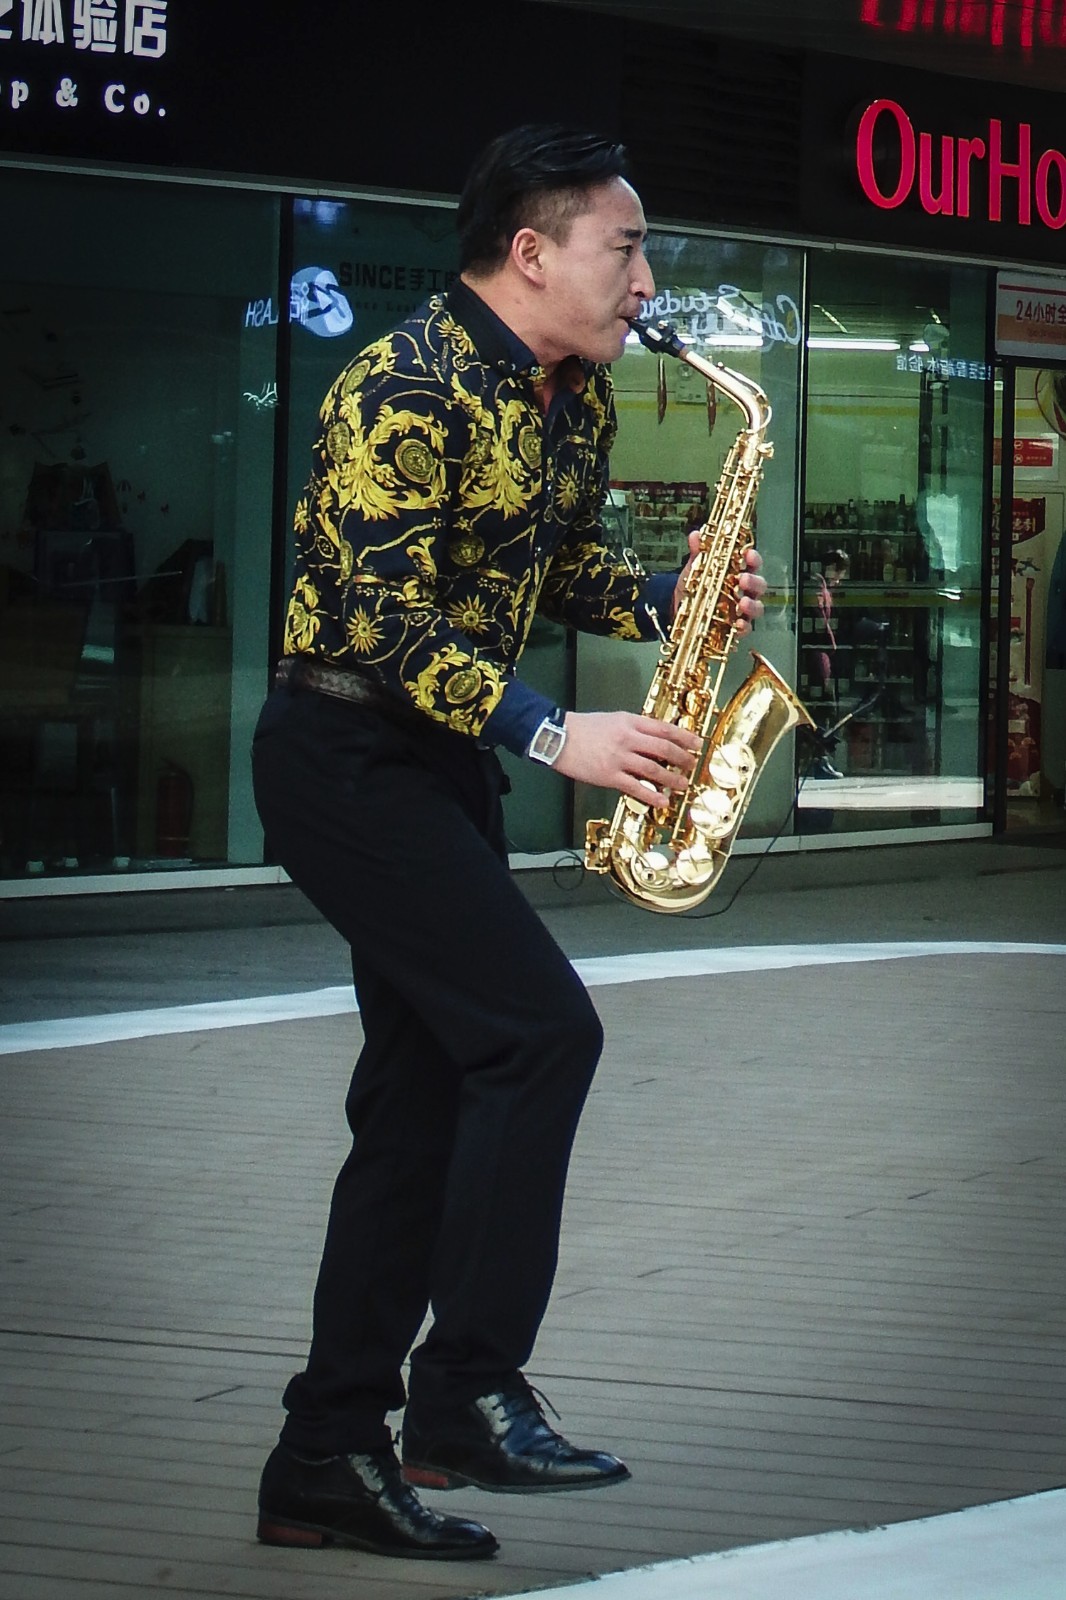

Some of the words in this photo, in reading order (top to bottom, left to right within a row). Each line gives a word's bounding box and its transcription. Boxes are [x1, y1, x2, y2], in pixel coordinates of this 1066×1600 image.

[55, 77, 79, 108] &
[104, 83, 167, 117] Co.
[856, 98, 1066, 230] OurHo
[1016, 299, 1066, 325] 24小时全
